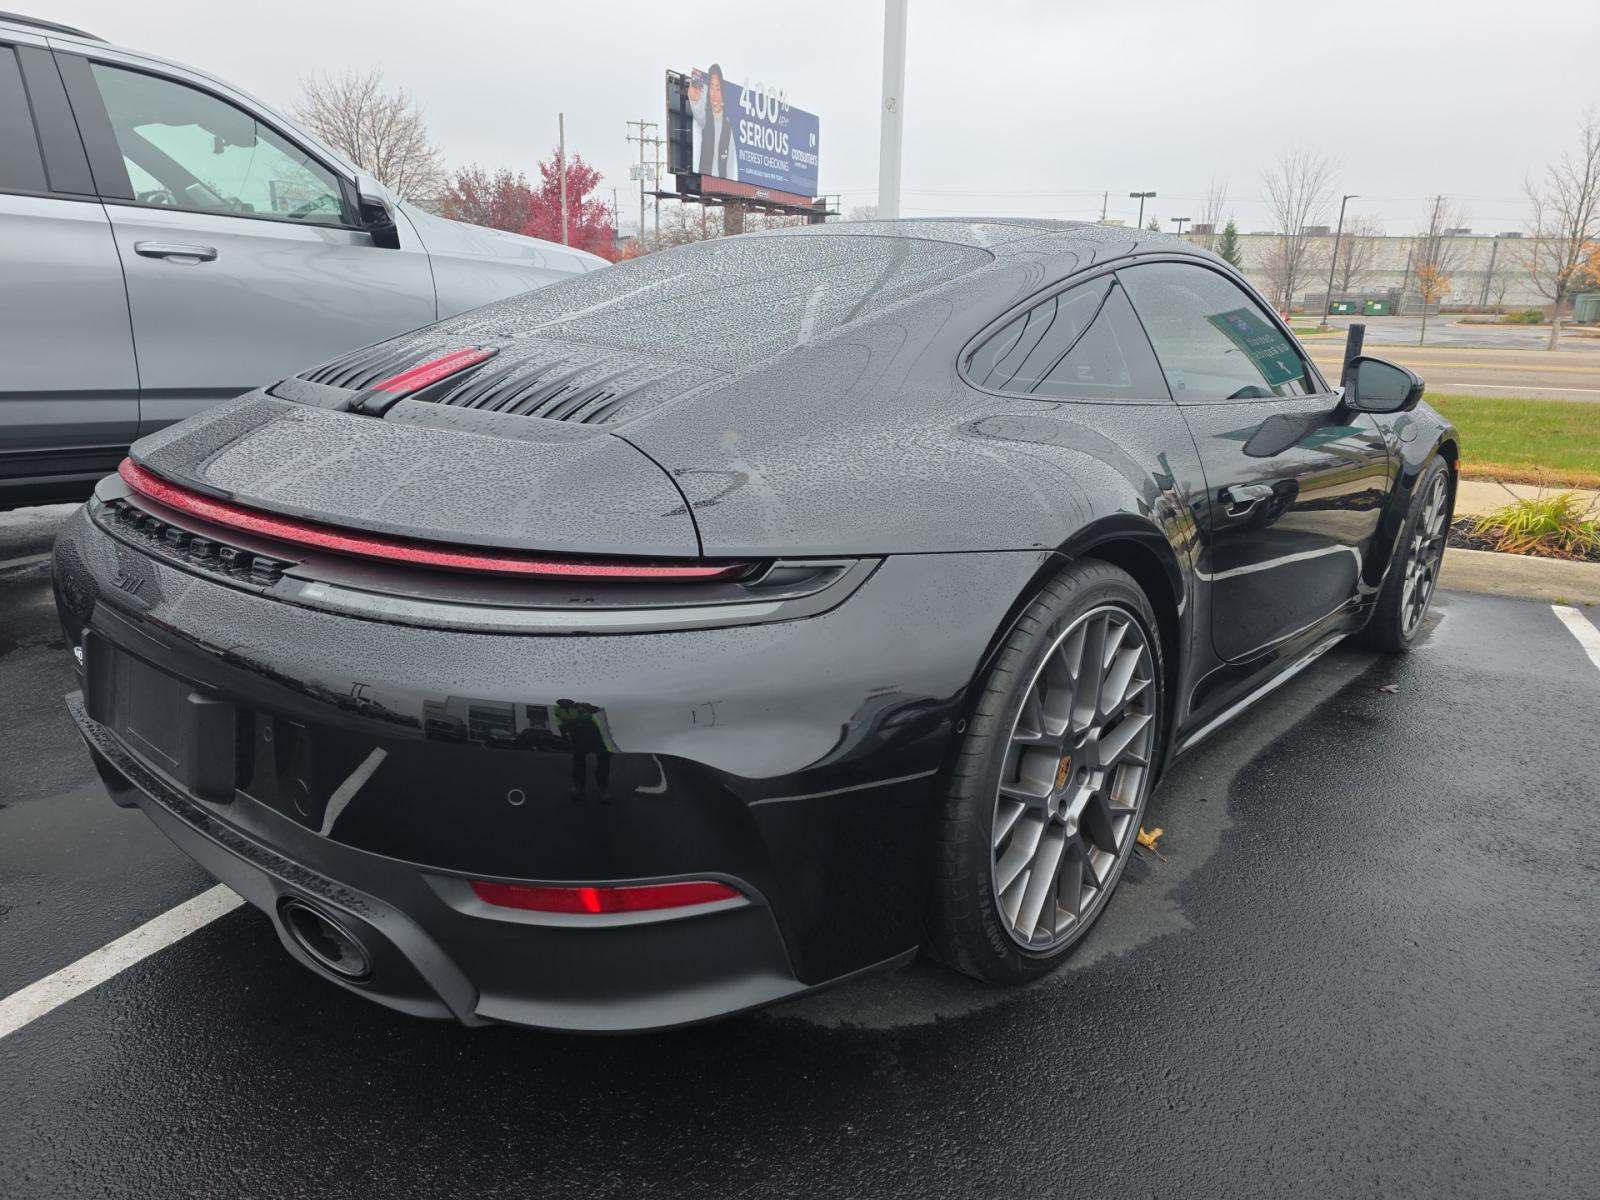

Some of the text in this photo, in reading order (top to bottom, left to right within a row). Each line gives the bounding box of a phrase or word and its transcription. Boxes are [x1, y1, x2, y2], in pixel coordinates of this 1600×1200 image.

[739, 119, 789, 155] SERIOUS
[739, 149, 763, 165] INTEREST
[763, 156, 789, 171] CHECKING
